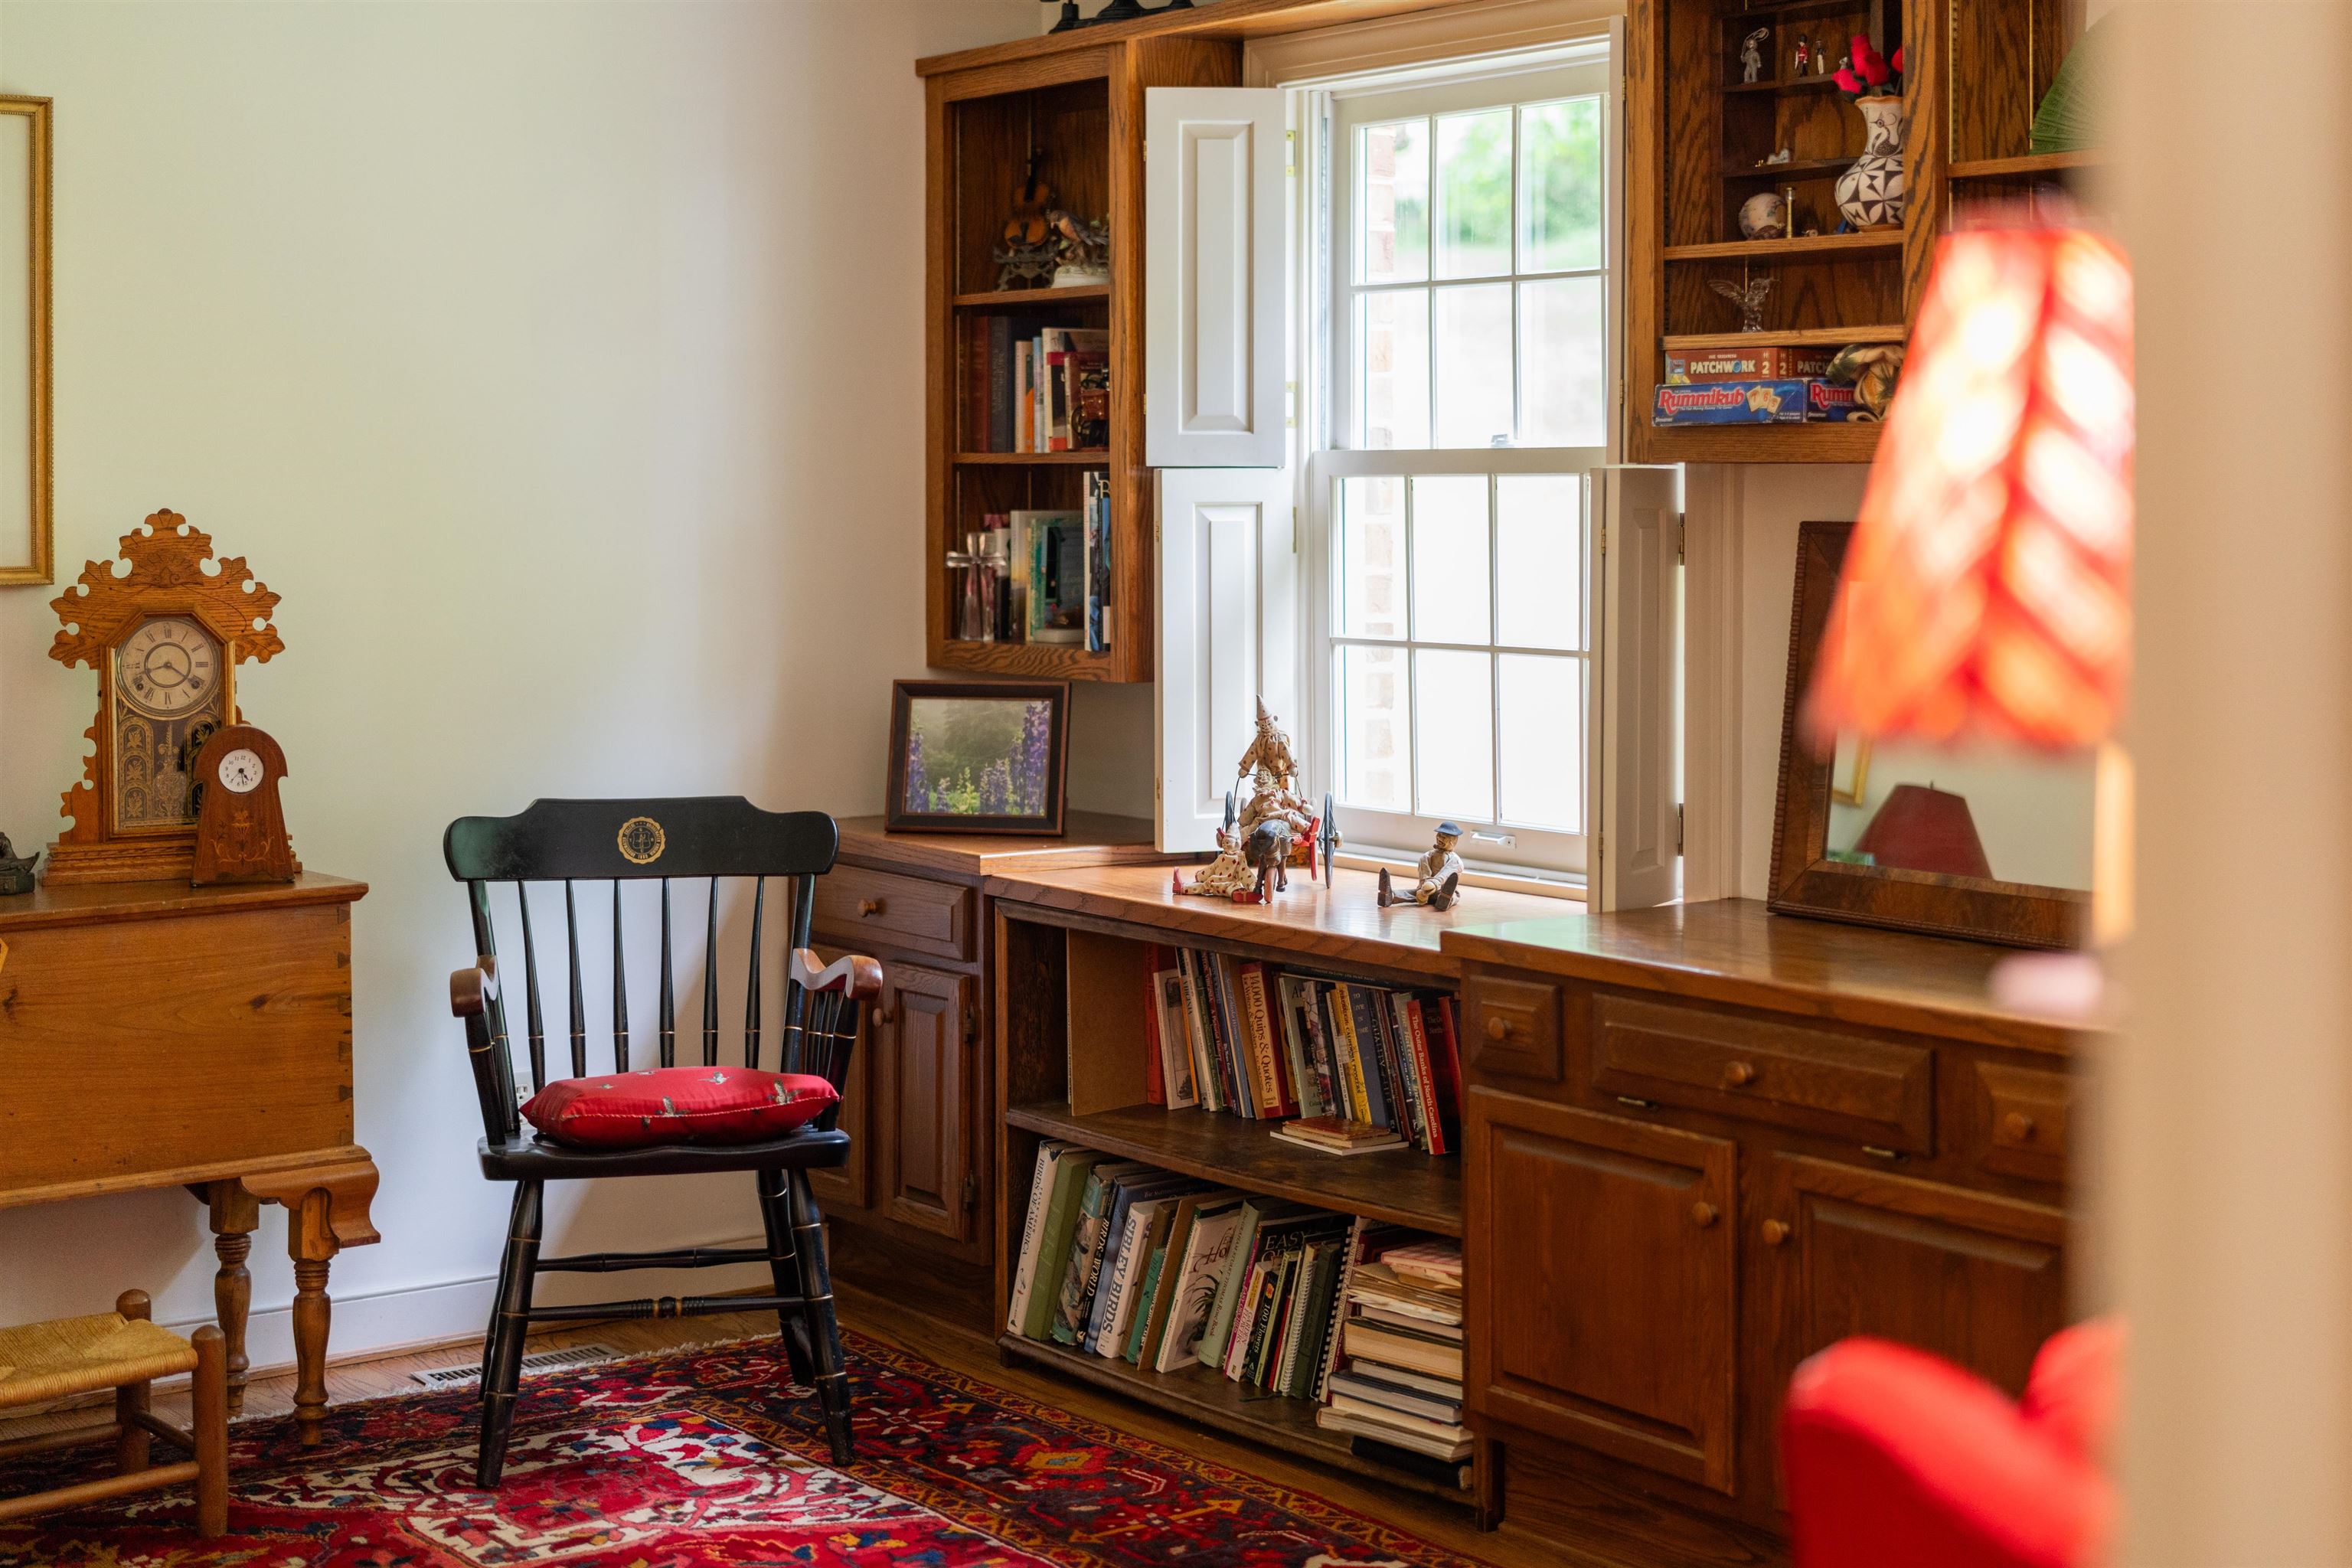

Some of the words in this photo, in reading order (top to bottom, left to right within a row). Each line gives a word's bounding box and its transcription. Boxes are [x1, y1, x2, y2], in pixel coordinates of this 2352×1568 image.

[1690, 359, 1756, 374] PATCHWORK
[1762, 361, 1770, 374] 2
[1779, 362, 1787, 374] 2
[1659, 387, 1745, 415] Rummikub
[1763, 392, 1768, 401] 6
[1182, 979, 1193, 1015] VIRGINIA
[1250, 974, 1262, 1007] 14,000
[1254, 1008, 1267, 1041] Quips
[1258, 1041, 1270, 1054] &
[1414, 1029, 1423, 1052] Outer
[1260, 1054, 1274, 1093] Quotes
[1418, 1052, 1427, 1075] Banks
[1422, 1075, 1429, 1084] of
[1424, 1084, 1433, 1106] North
[1427, 1106, 1438, 1138] Carolina
[1034, 1158, 1045, 1190] BIRDS
[1030, 1191, 1038, 1208] OF
[1021, 1208, 1035, 1256] AMERICA
[1096, 1217, 1109, 1252] BIRDS
[1263, 1228, 1304, 1250] EASY
[1114, 1215, 1138, 1279] SIBLEY
[1085, 1257, 1101, 1297] WORLD
[1226, 1251, 1237, 1276] STUART
[1218, 1276, 1230, 1304] THOMAS
[1101, 1279, 1123, 1333] BIRDS
[1261, 1303, 1271, 1321] 100
[1208, 1320, 1218, 1336] Book
[1235, 1308, 1249, 1344] FLOWERS
[1240, 1311, 1253, 1345] GARDEN
[1253, 1322, 1267, 1353] Flowers
